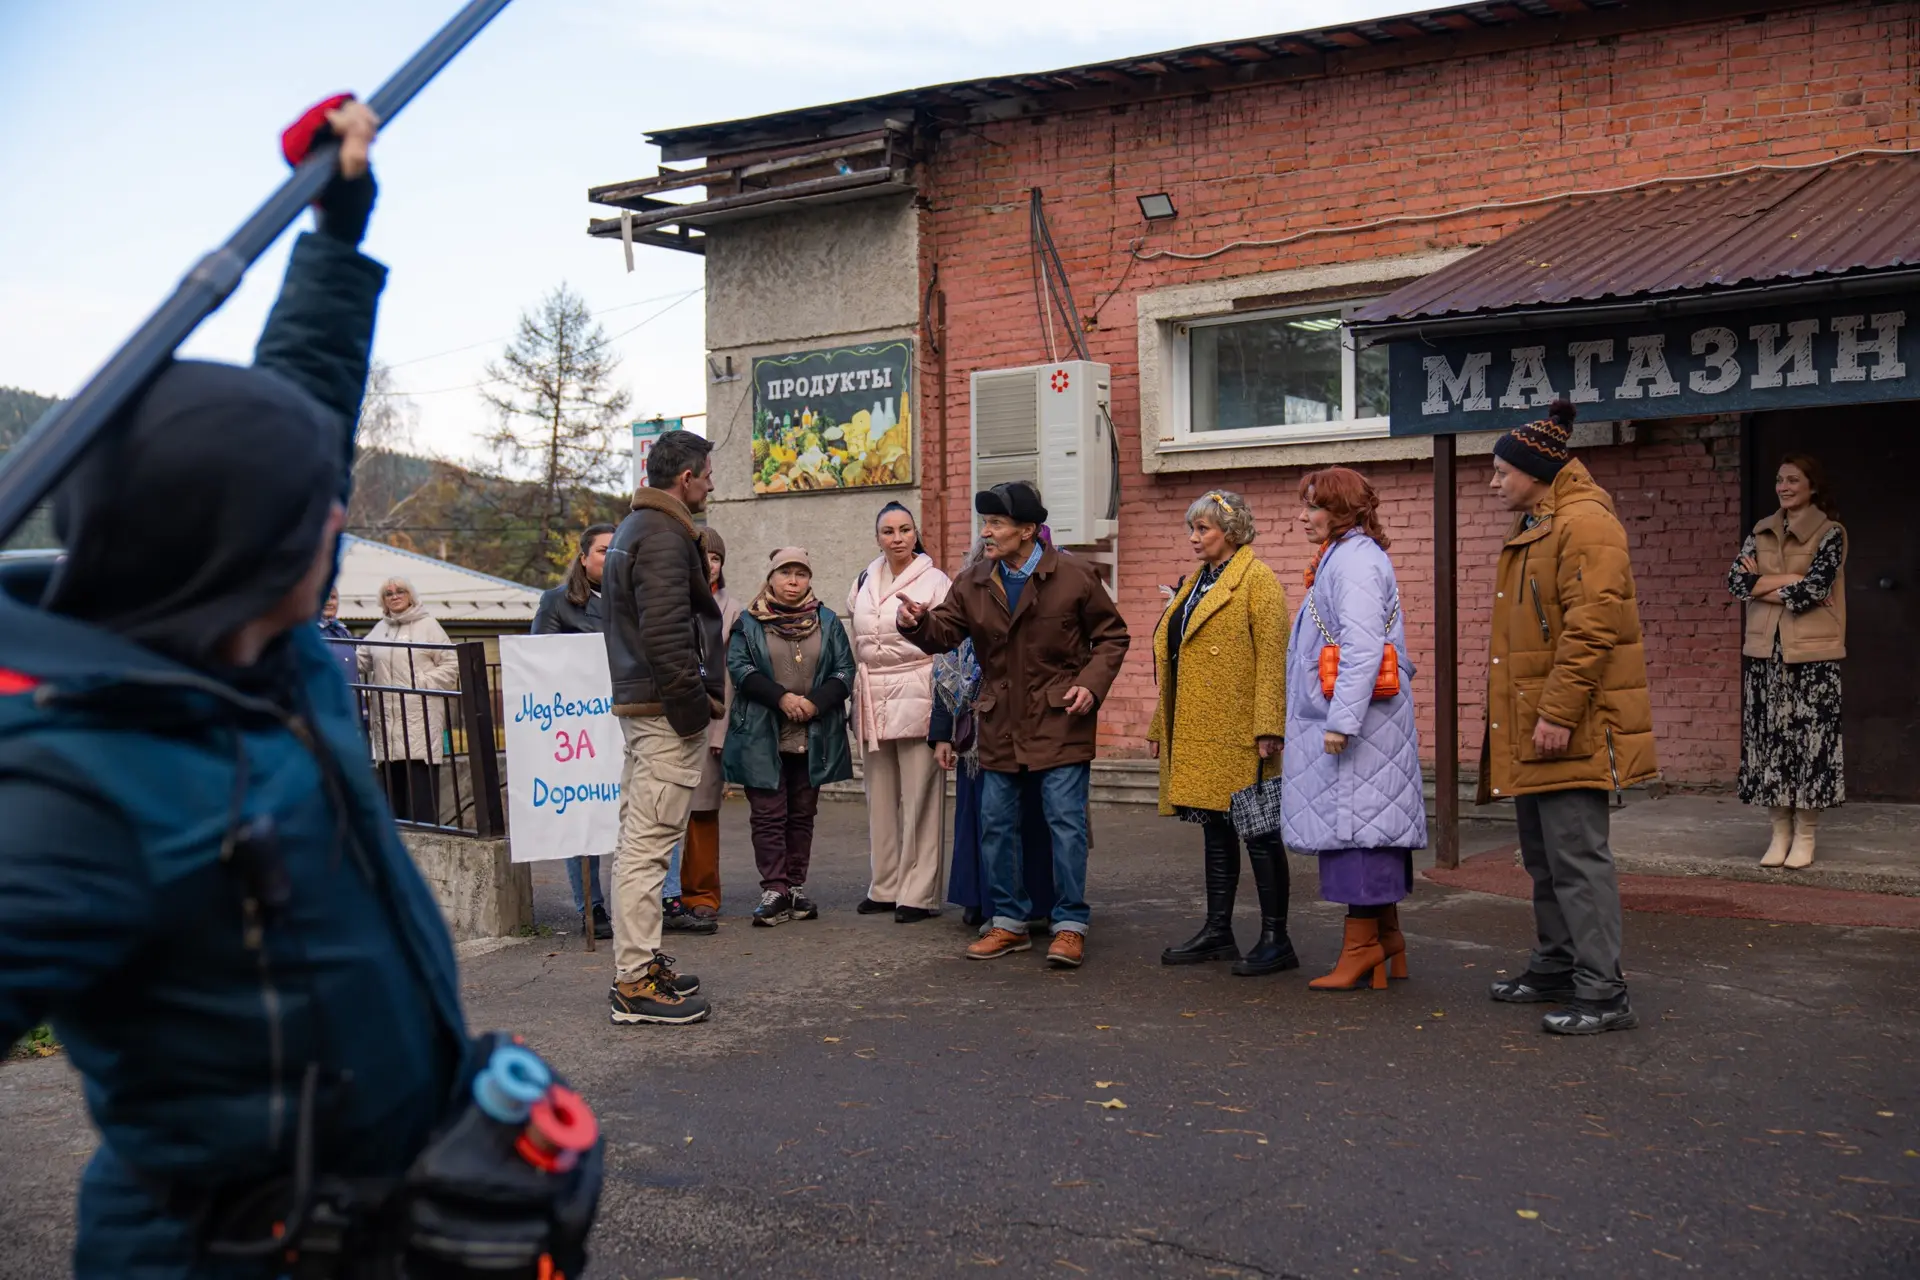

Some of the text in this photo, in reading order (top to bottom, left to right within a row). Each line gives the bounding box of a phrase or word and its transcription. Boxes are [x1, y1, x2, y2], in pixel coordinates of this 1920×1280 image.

[1421, 310, 1907, 416] МАГАЗИН
[767, 367, 893, 401] ПРОДУКТЫ
[554, 729, 596, 762] ЗА
